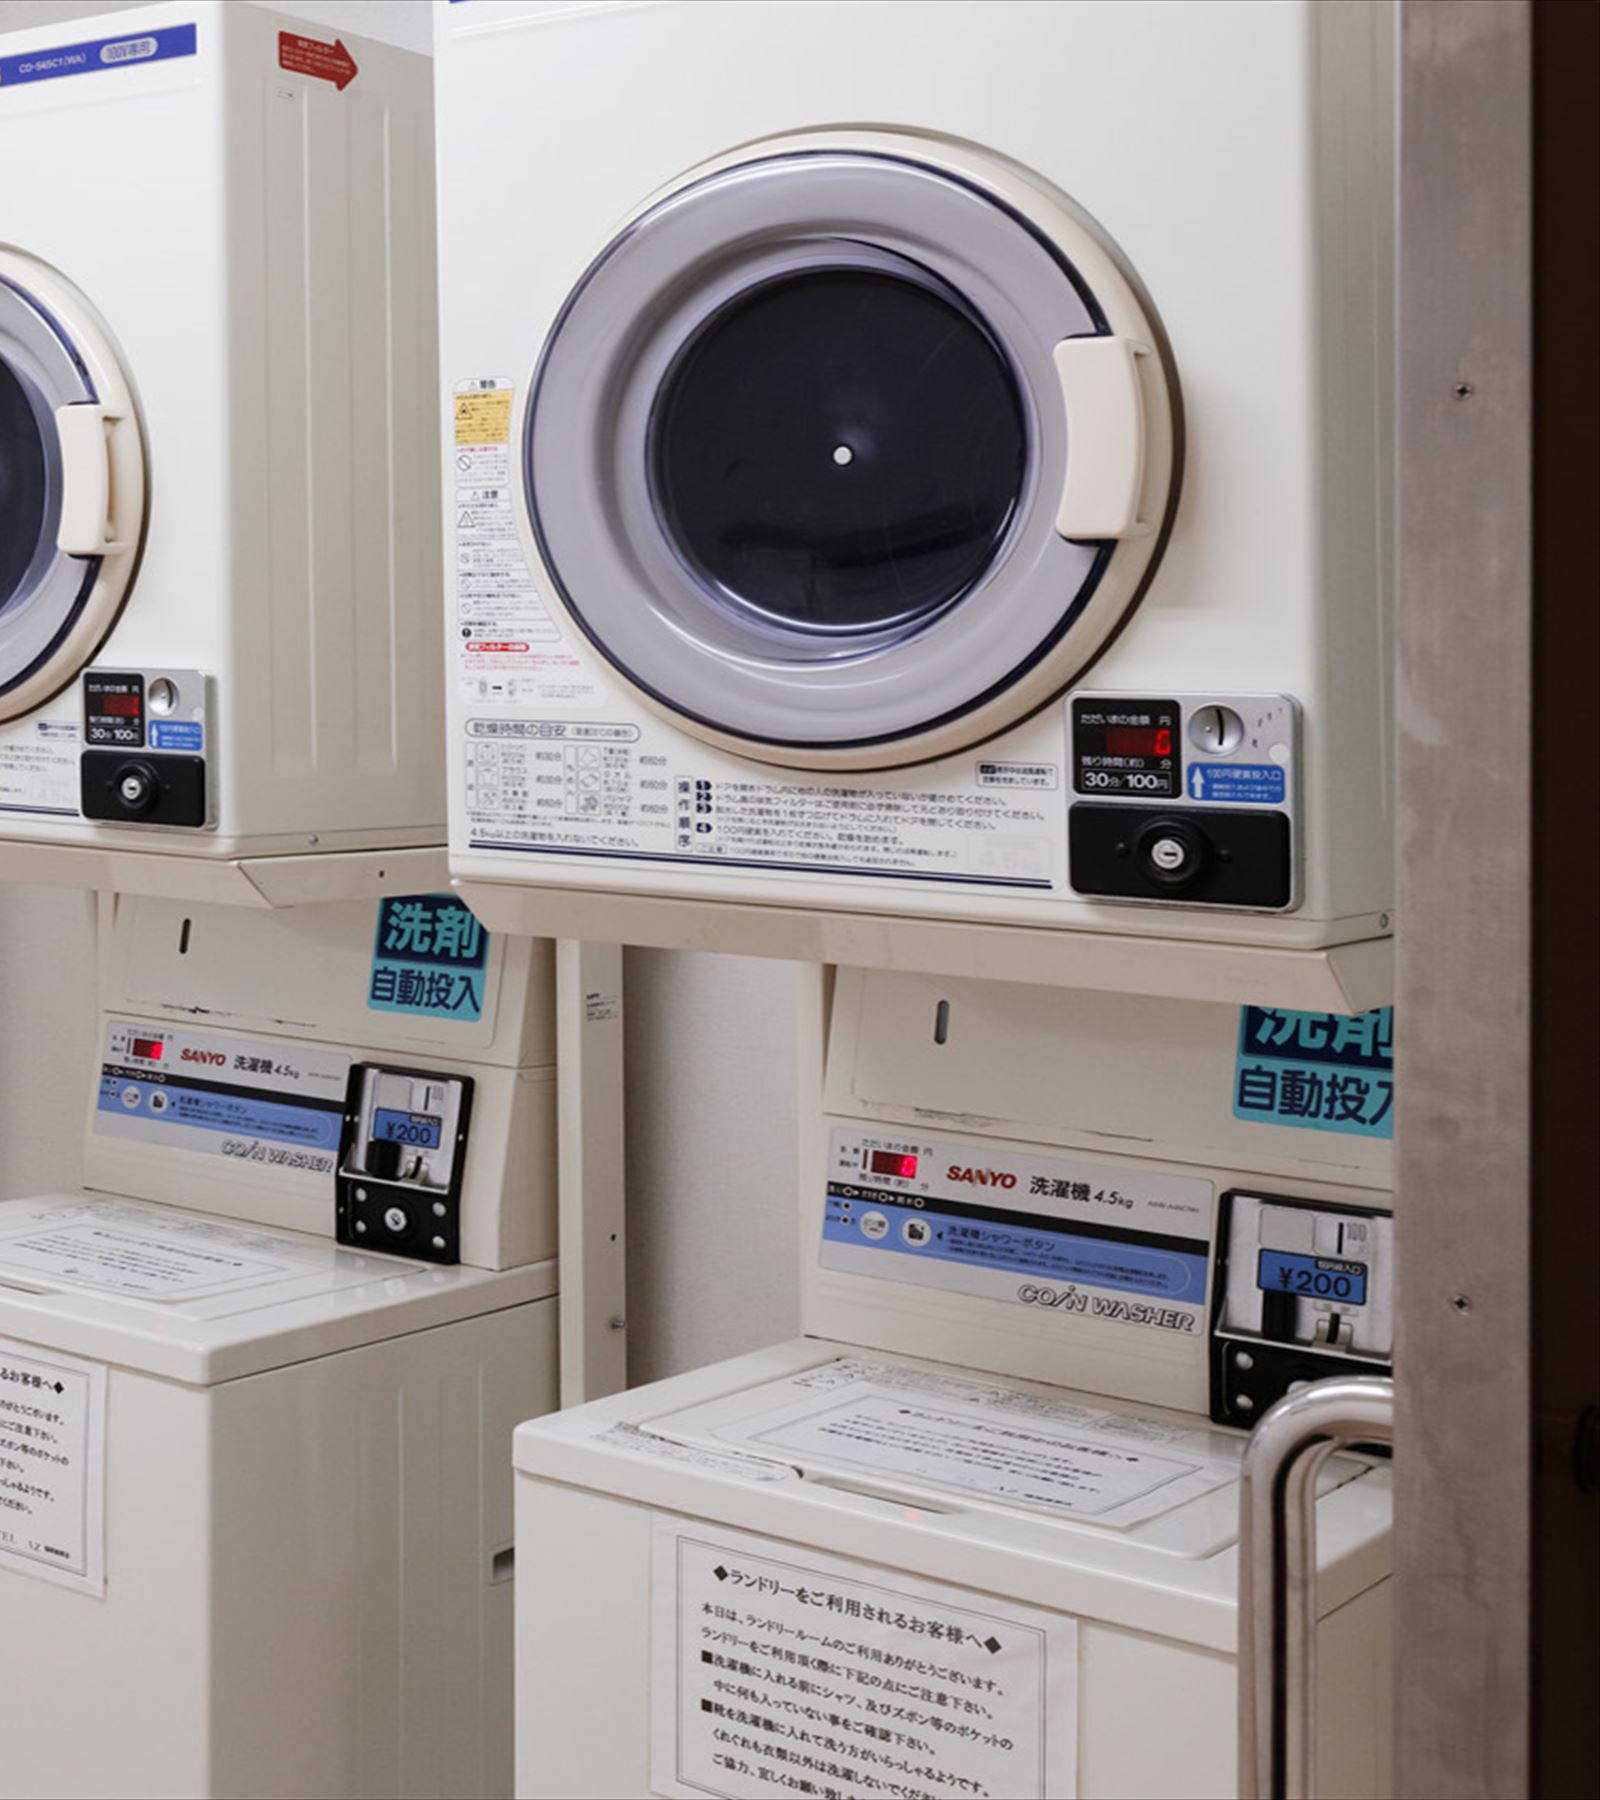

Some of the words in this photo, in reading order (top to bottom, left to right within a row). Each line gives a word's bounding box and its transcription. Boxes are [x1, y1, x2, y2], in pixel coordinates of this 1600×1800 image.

[473, 721, 567, 738] 乾燥時間の目安
[1080, 714, 1150, 725] ただいまの金額
[1159, 715, 1172, 726] 円
[383, 901, 481, 958] 洗剤
[370, 966, 481, 1014] 自動投入
[180, 1048, 227, 1066] SANYO
[233, 1055, 273, 1075] 洗濯機
[274, 1065, 300, 1079] 4.5kg
[386, 1120, 432, 1144] ¥200
[946, 1165, 1017, 1189] SANYO
[1029, 1175, 1091, 1203] 洗濯機
[1094, 1189, 1134, 1209] 4.5kg
[1279, 1266, 1351, 1298] ¥200
[1093, 1296, 1196, 1332] WASHER
[729, 1568, 983, 1649] ランドリーをご利用されるお客様へ
[701, 1602, 1004, 1697] 本日は、ランドリールームのご利用ありがとうございます。
[701, 1626, 993, 1720] ランドリーをご利用頂く際に下記の点にご注意下さい。
[713, 1679, 936, 1756] 中に何も入っていない事をご確認下さい。
